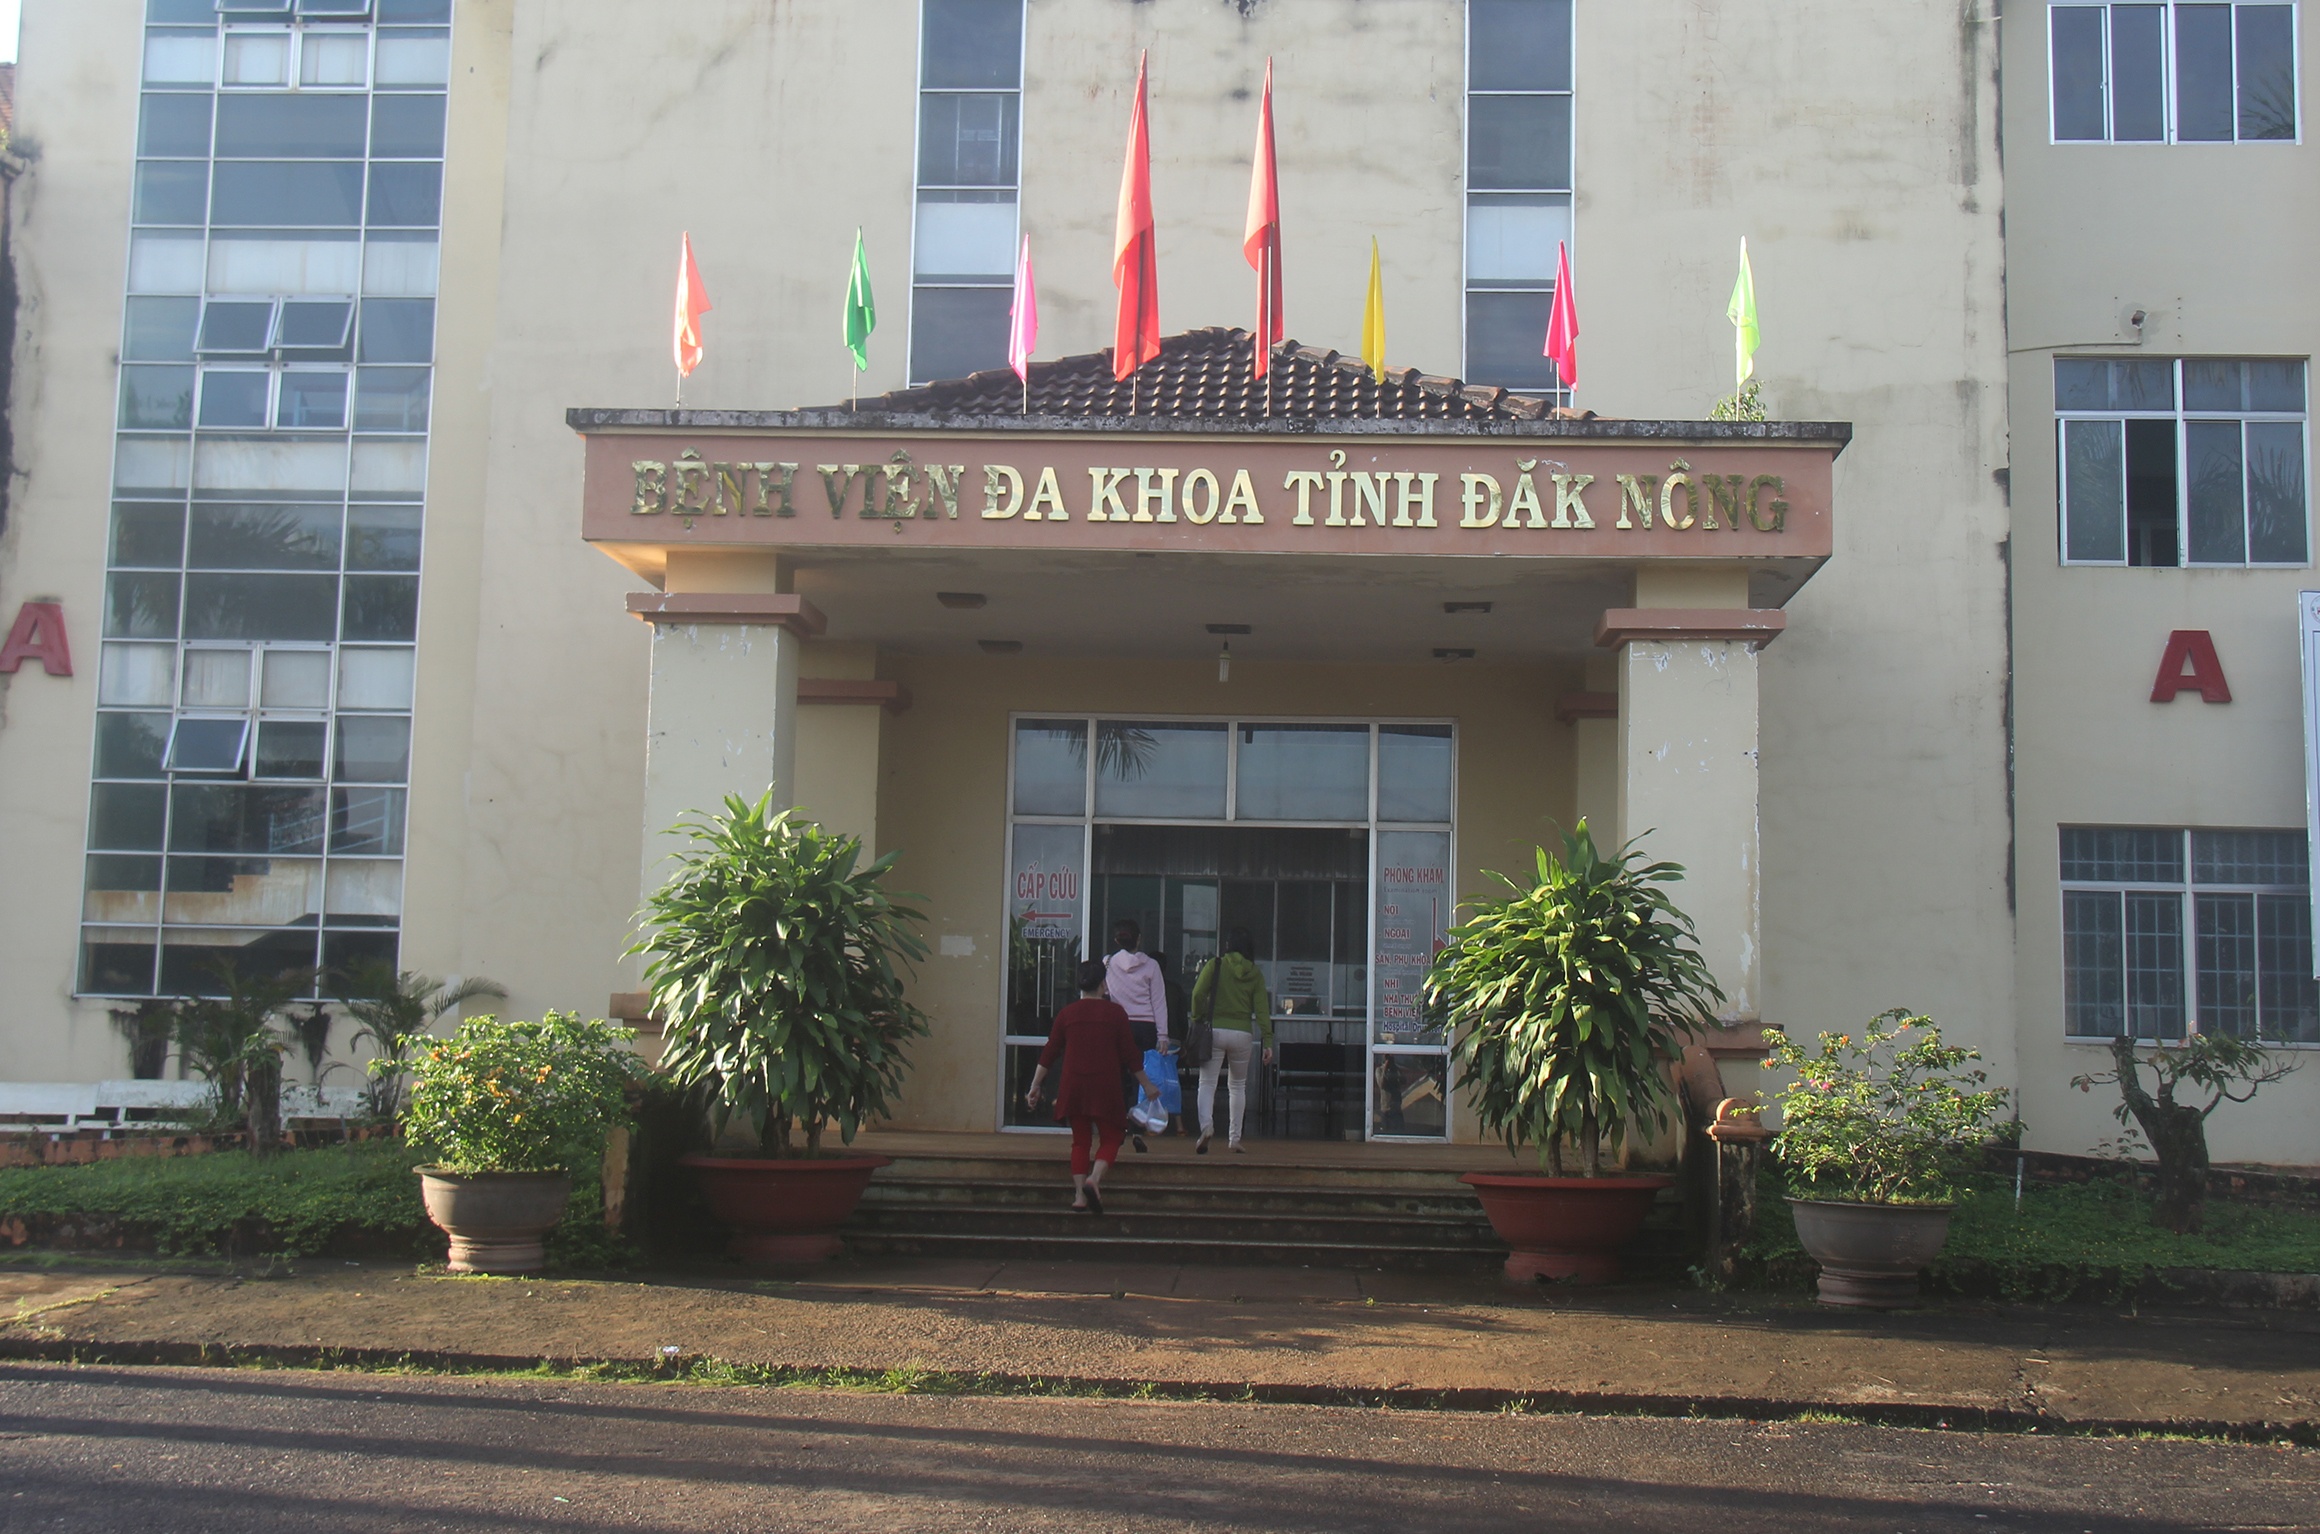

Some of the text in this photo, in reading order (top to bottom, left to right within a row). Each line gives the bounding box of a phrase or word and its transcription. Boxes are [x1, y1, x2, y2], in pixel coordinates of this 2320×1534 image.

[631, 446, 1789, 534] BỆNH VIỆN ĐA KHOA TỈNH ĐĂK NÔNG
[0, 602, 74, 677] A
[2149, 629, 2233, 703] A
[1017, 861, 1077, 899] CẤP CỨU
[1383, 862, 1414, 883] PHÒNG
[1022, 928, 1071, 938] EMERGENCY
[1383, 978, 1399, 989] NHI
